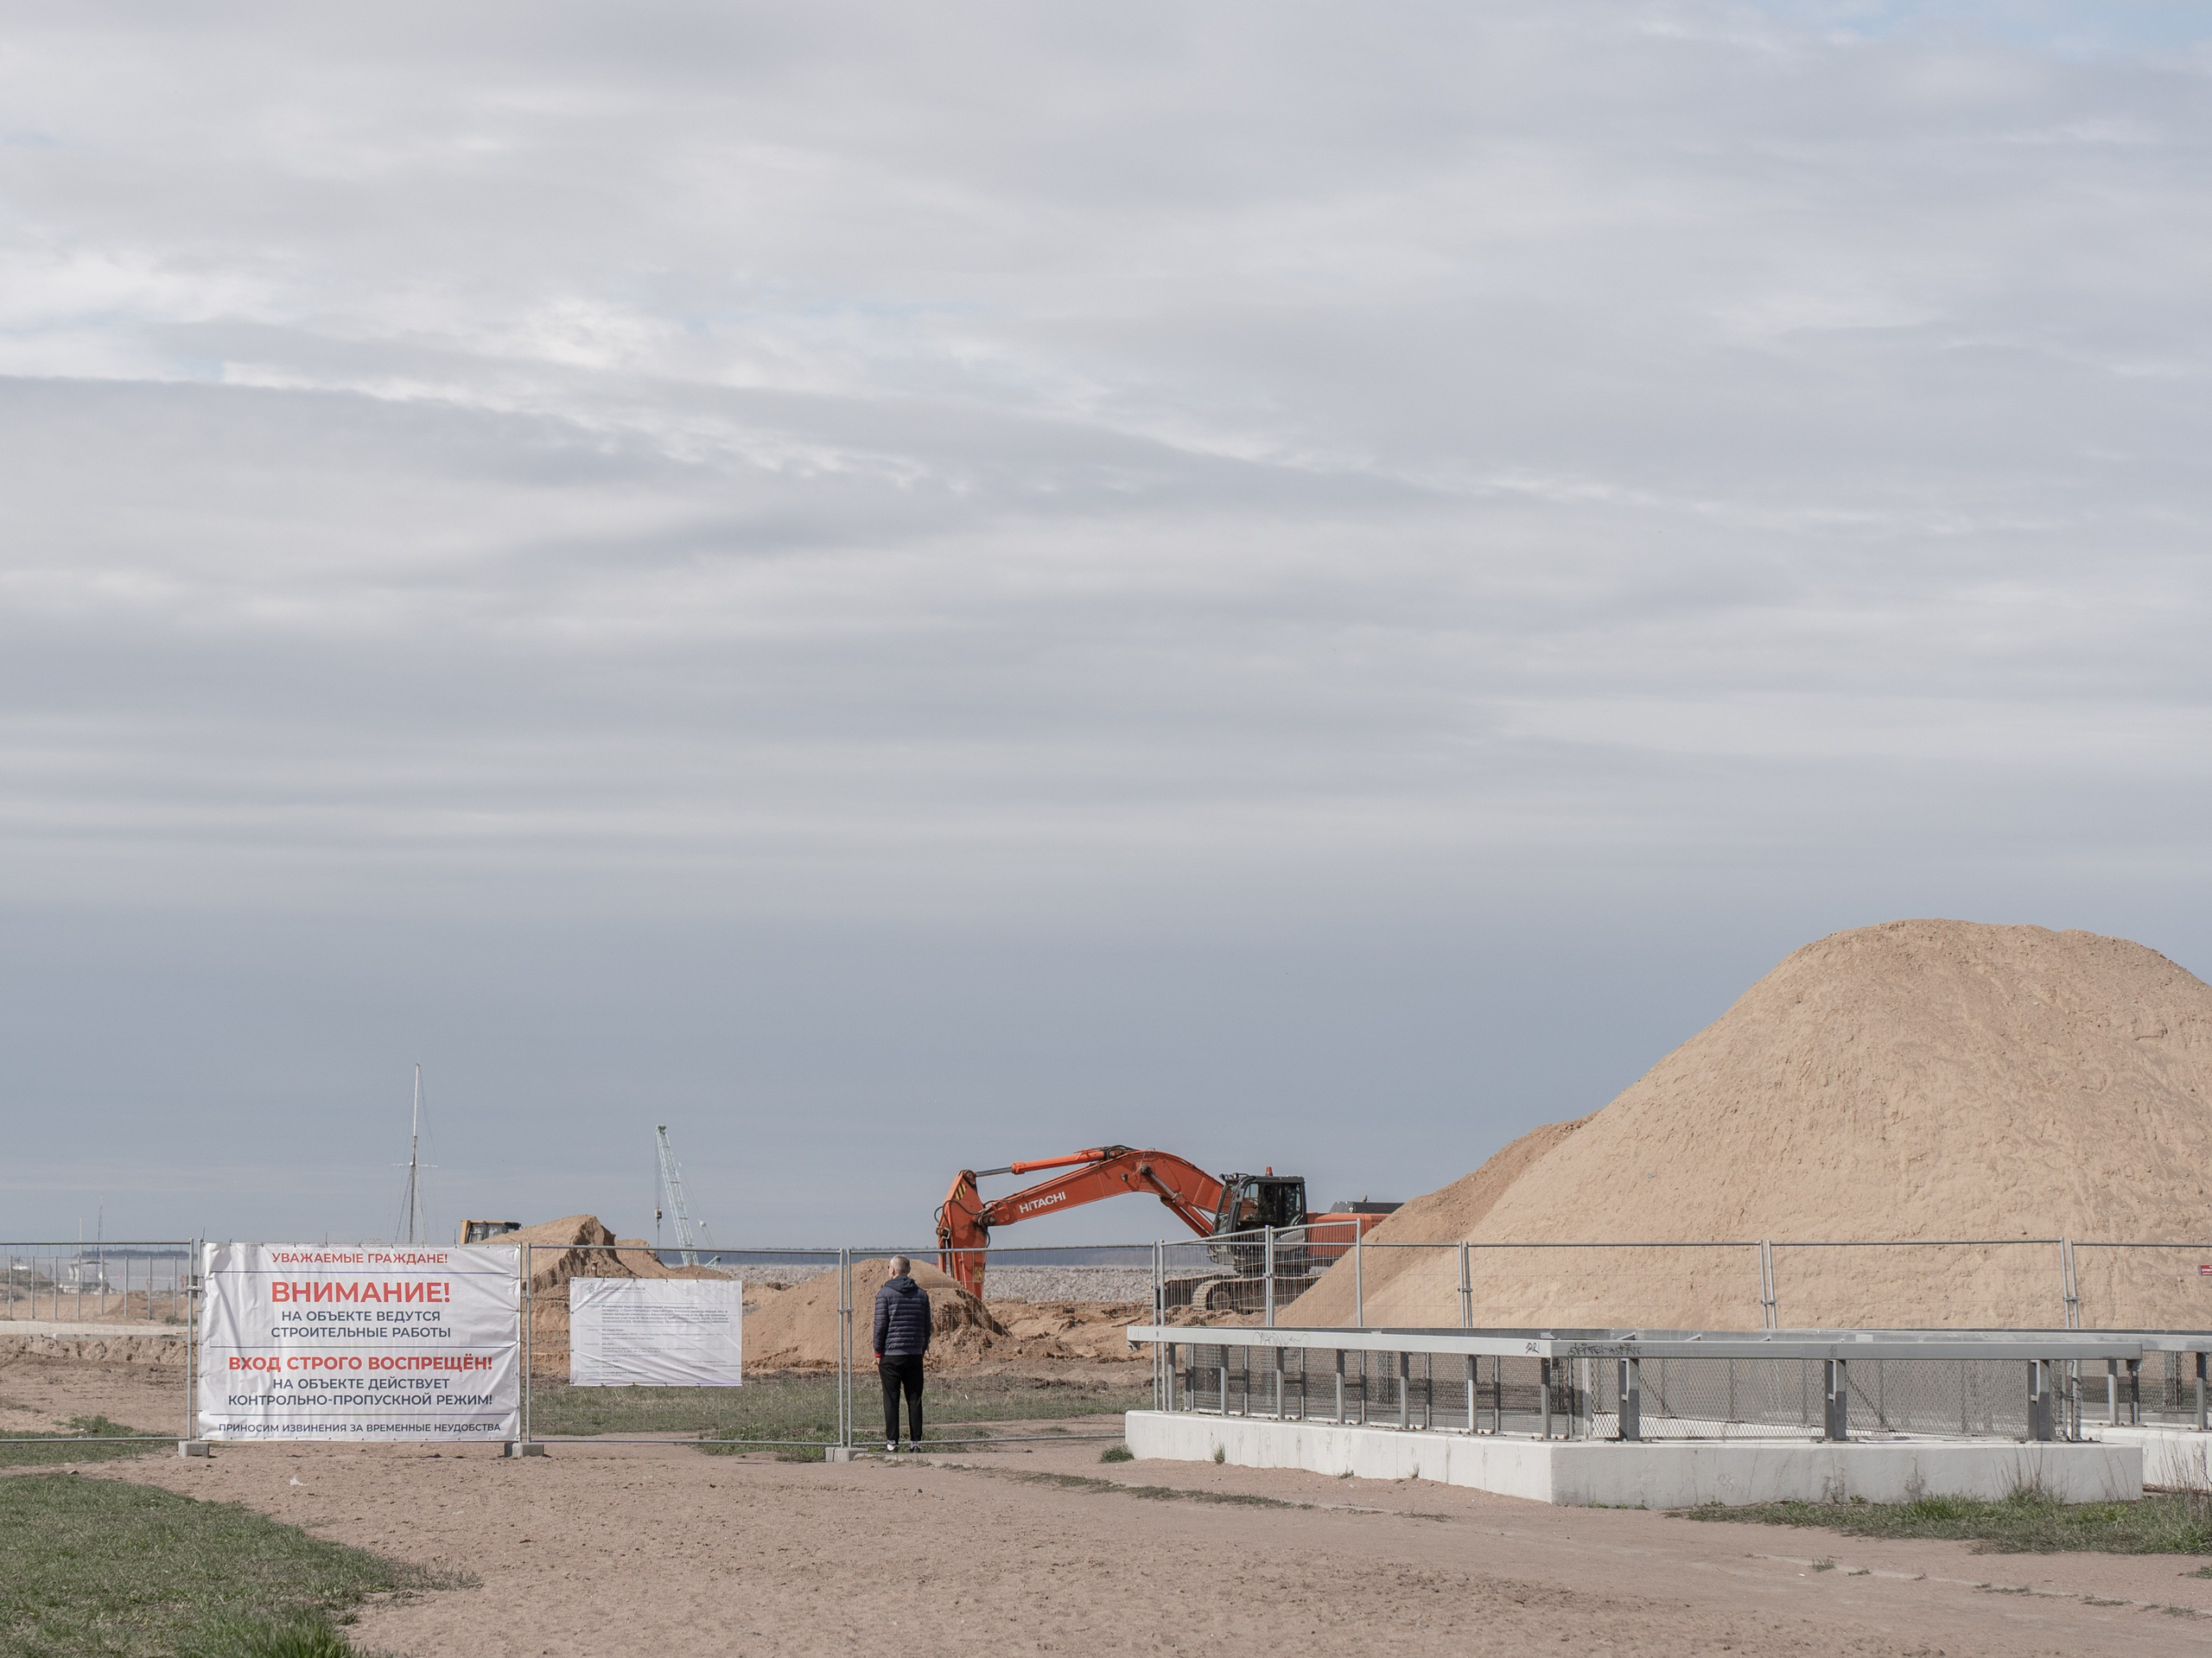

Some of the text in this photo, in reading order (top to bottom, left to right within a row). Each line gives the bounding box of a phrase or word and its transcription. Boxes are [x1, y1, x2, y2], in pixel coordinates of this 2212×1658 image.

[1019, 1191, 1066, 1214] HITACHI
[272, 1252, 448, 1265] УВАЖАЕМЫЕ ГРАЖДАНЕ!
[271, 1281, 450, 1303] ВНИМАНИЕ!
[282, 1311, 441, 1324] НА ОБЪЕКТЕ ВЕДУТСЯ
[270, 1327, 451, 1338] СТРОИТЕЛЬНЫЕ РАБОТЫ
[229, 1355, 493, 1373] ВХОД СТРОГО ВОСПРЕЩЁН!
[273, 1377, 450, 1391] НА ОБЪЕКТЕ ДЕЙСТВУЕТ
[228, 1393, 493, 1406] КОНТРОЛЬНО-ПРОПУСКНОЙ РЕЖИМ!
[219, 1423, 500, 1433] ПРИНОСИМ ИЗВИНЕНИЯ ЗА ВРЕМЕННЫЕ НЕУДОБСТВА
